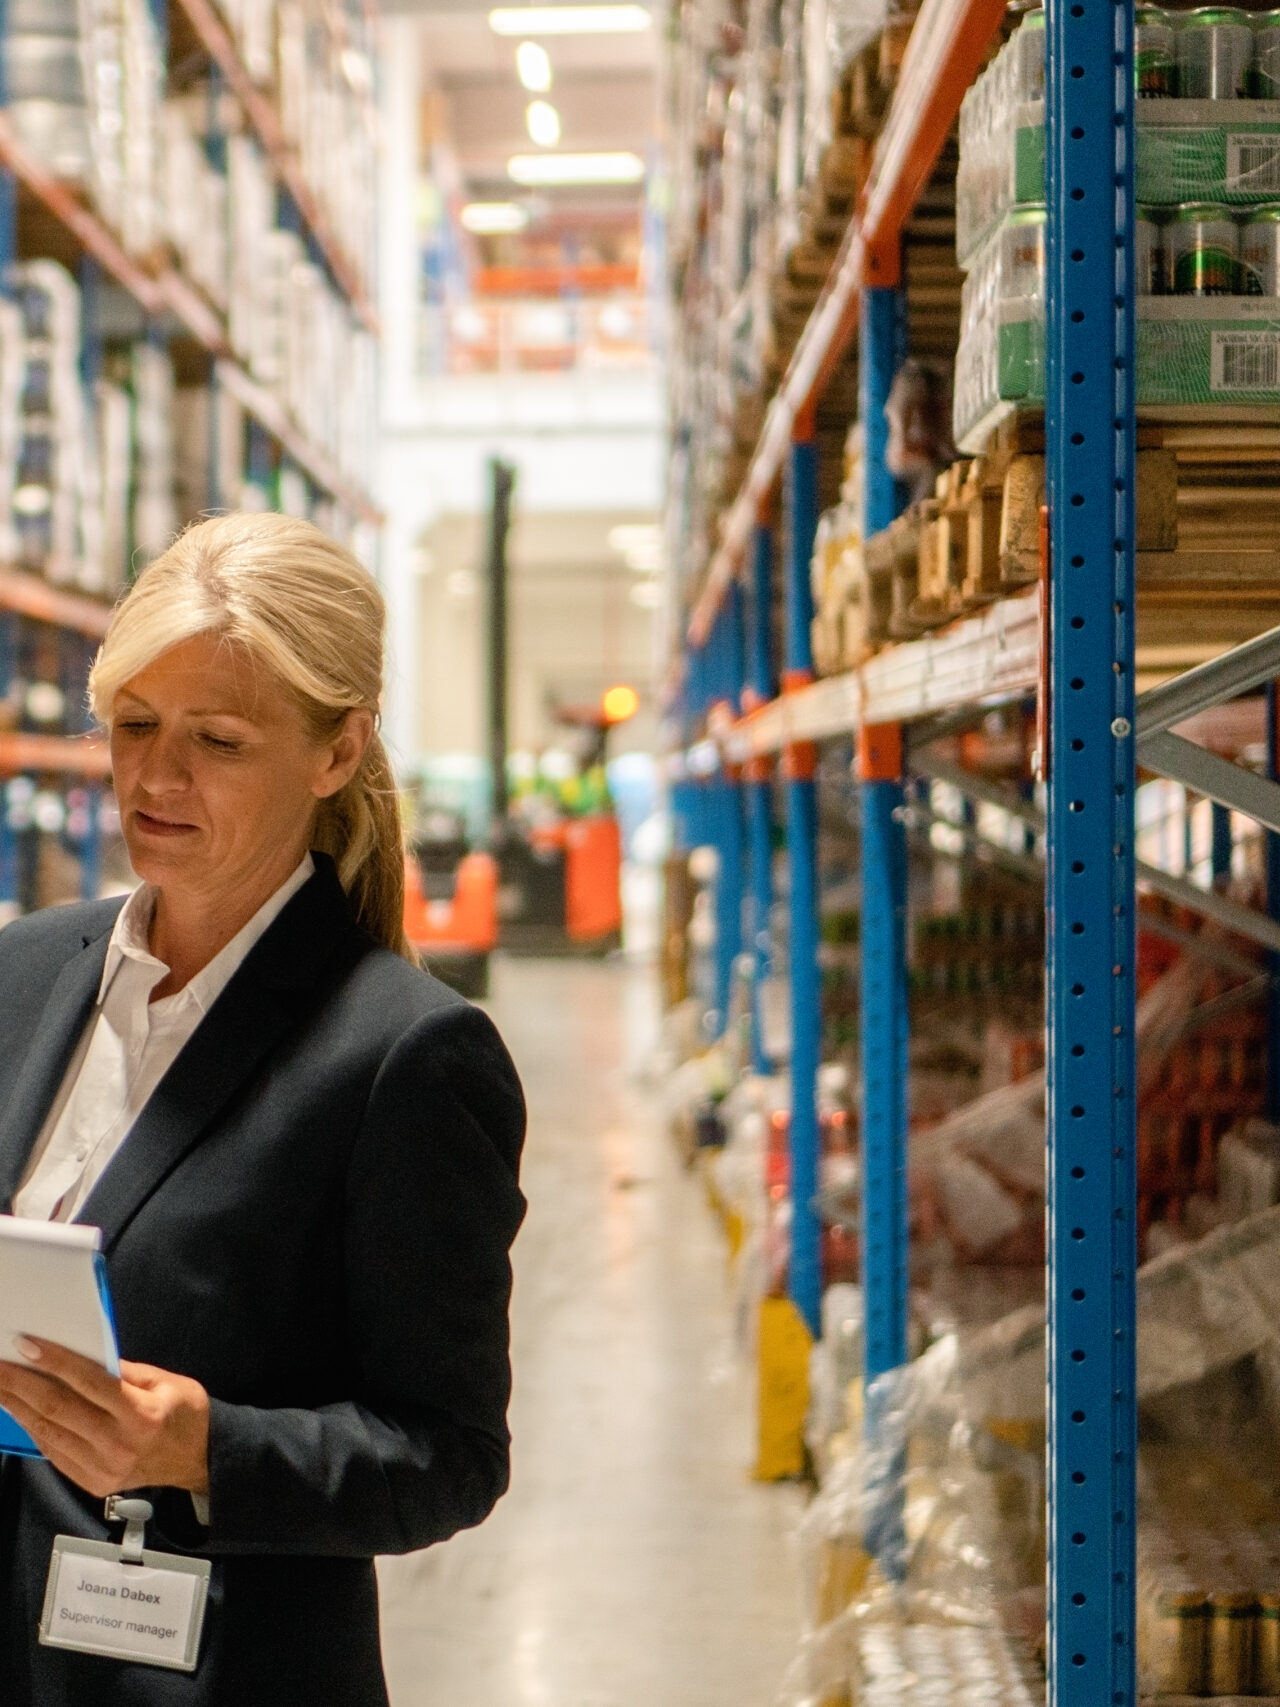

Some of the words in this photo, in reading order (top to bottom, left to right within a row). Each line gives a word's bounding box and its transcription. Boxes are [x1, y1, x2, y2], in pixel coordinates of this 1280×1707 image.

[77, 1580, 117, 1597] Joana
[120, 1587, 160, 1604] Dabex
[60, 1607, 122, 1629] Supervisor
[126, 1621, 178, 1639] manager
